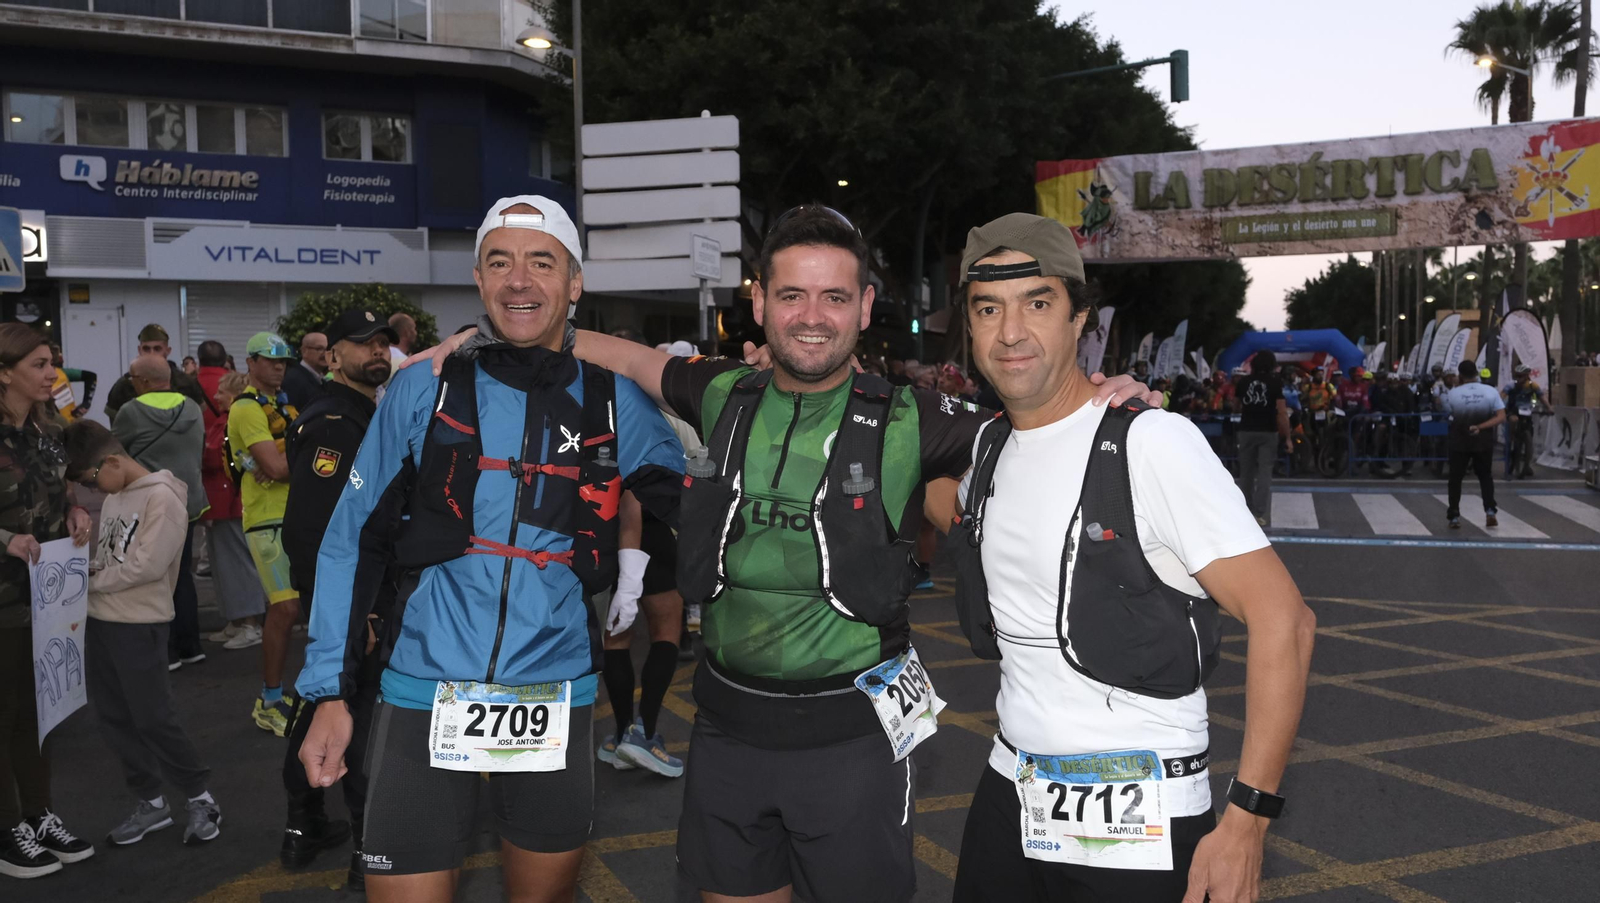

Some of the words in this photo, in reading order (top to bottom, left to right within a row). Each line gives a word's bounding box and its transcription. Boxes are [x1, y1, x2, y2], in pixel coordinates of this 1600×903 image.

[114, 159, 260, 189] Háblame
[326, 173, 392, 188] Logopedia
[1132, 168, 1192, 211] LA
[1201, 147, 1499, 209] DESÉRTICA
[114, 185, 159, 198] Centro
[163, 187, 259, 203] Interdisciplinar
[323, 189, 396, 206] Fisioterapia
[1238, 222, 1249, 234] La
[1252, 221, 1280, 235] Legión
[1283, 222, 1289, 233] y
[1292, 220, 1301, 231] el
[1304, 219, 1339, 231] desierto
[1342, 219, 1358, 228] nos
[1360, 217, 1377, 228] une
[204, 245, 382, 266] VITALDENT
[463, 703, 549, 738] 2709
[441, 742, 456, 750] BUS
[497, 738, 513, 746] JOSE
[515, 738, 546, 746] ANTONIO
[1059, 754, 1157, 774] DESÉRTICA
[1046, 782, 1146, 825] 2712
[1033, 828, 1047, 836] BUS
[1107, 826, 1144, 835] SAMUEL
